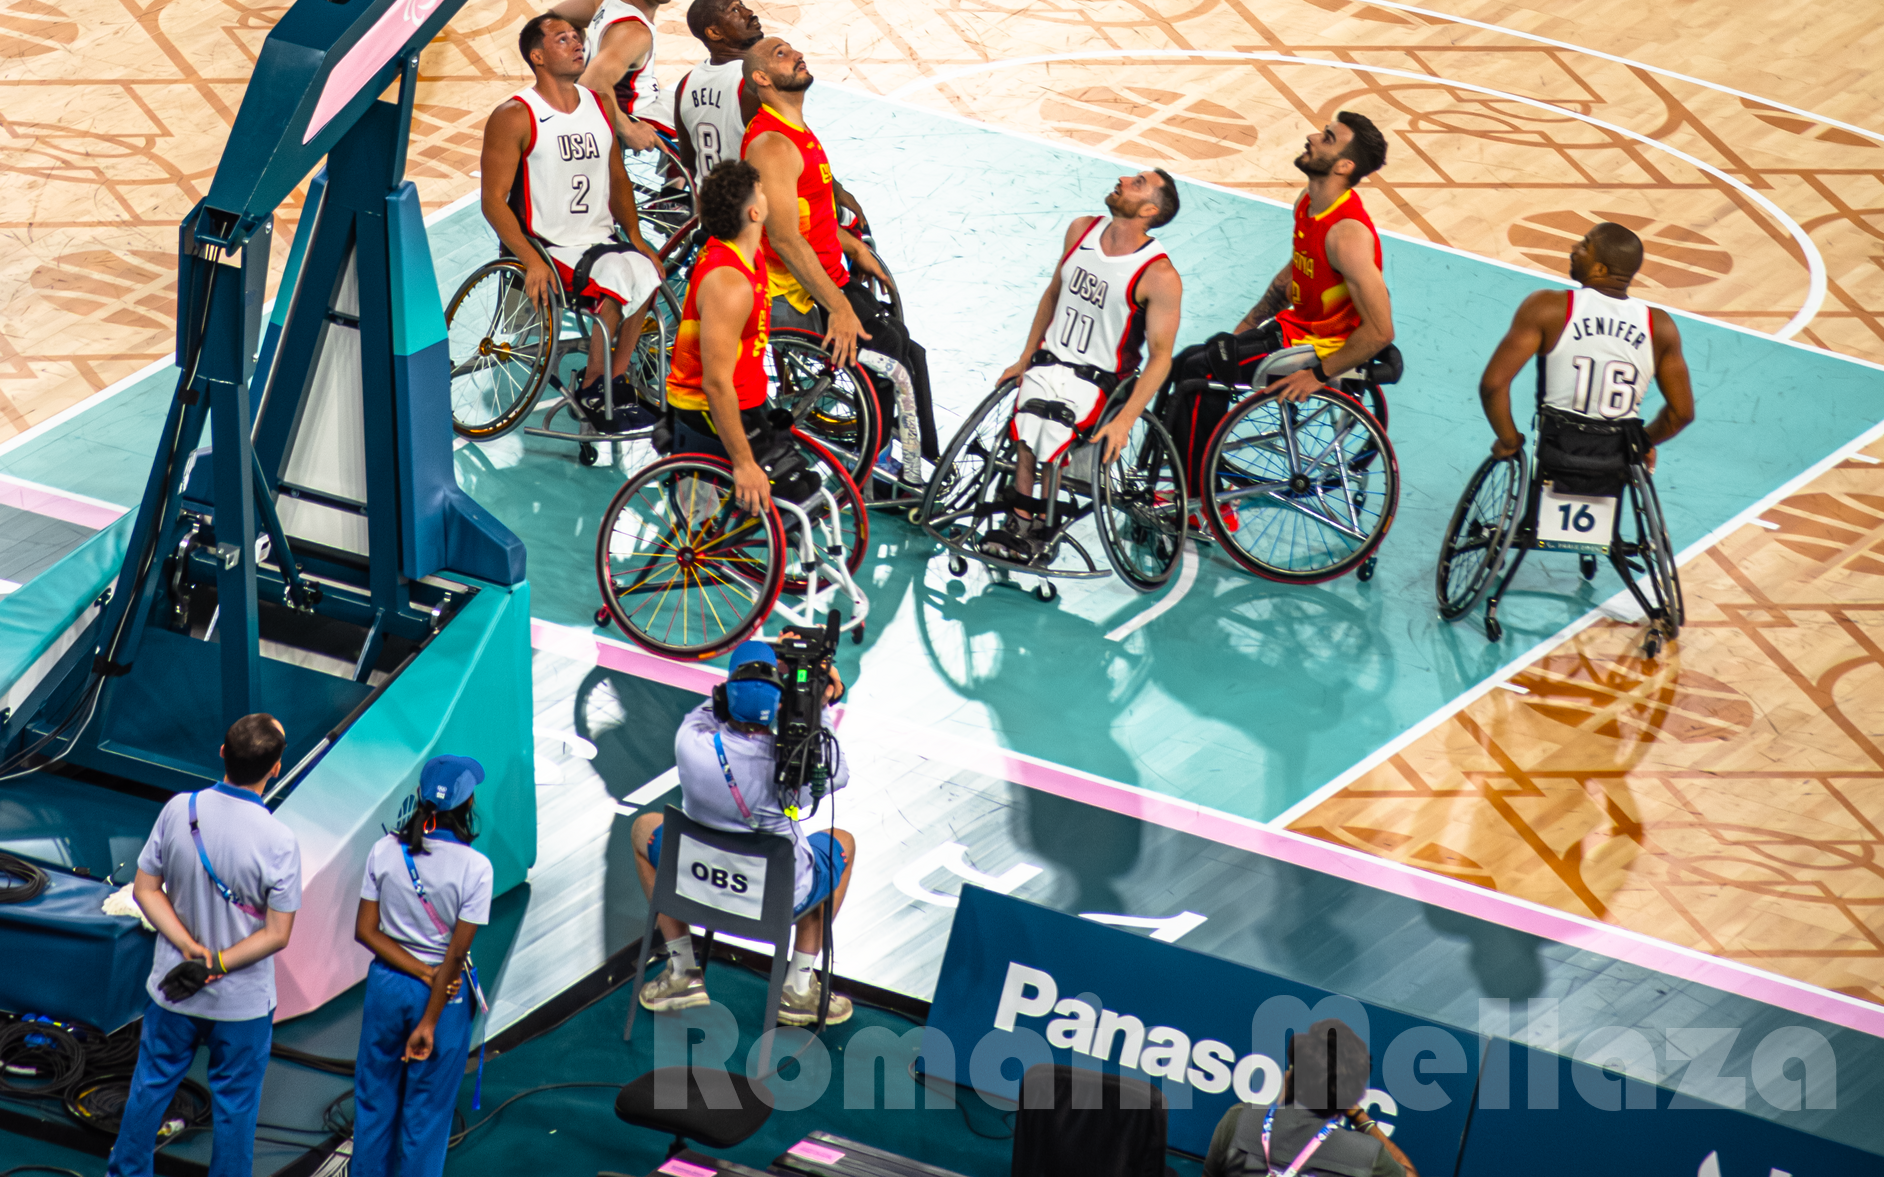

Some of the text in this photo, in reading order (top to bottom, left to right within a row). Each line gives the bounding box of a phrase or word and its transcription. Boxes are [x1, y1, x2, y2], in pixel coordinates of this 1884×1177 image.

[692, 87, 721, 109] BELL
[557, 132, 600, 161] USA
[697, 122, 722, 178] 8
[570, 174, 590, 214] 2
[1069, 266, 1109, 310] USA
[1061, 306, 1095, 354] 11
[1573, 316, 1647, 350] JENIFER
[1572, 355, 1639, 420] 16
[1558, 503, 1596, 533] 16
[691, 861, 749, 894] OBS
[994, 961, 1398, 1137] Panasoc
